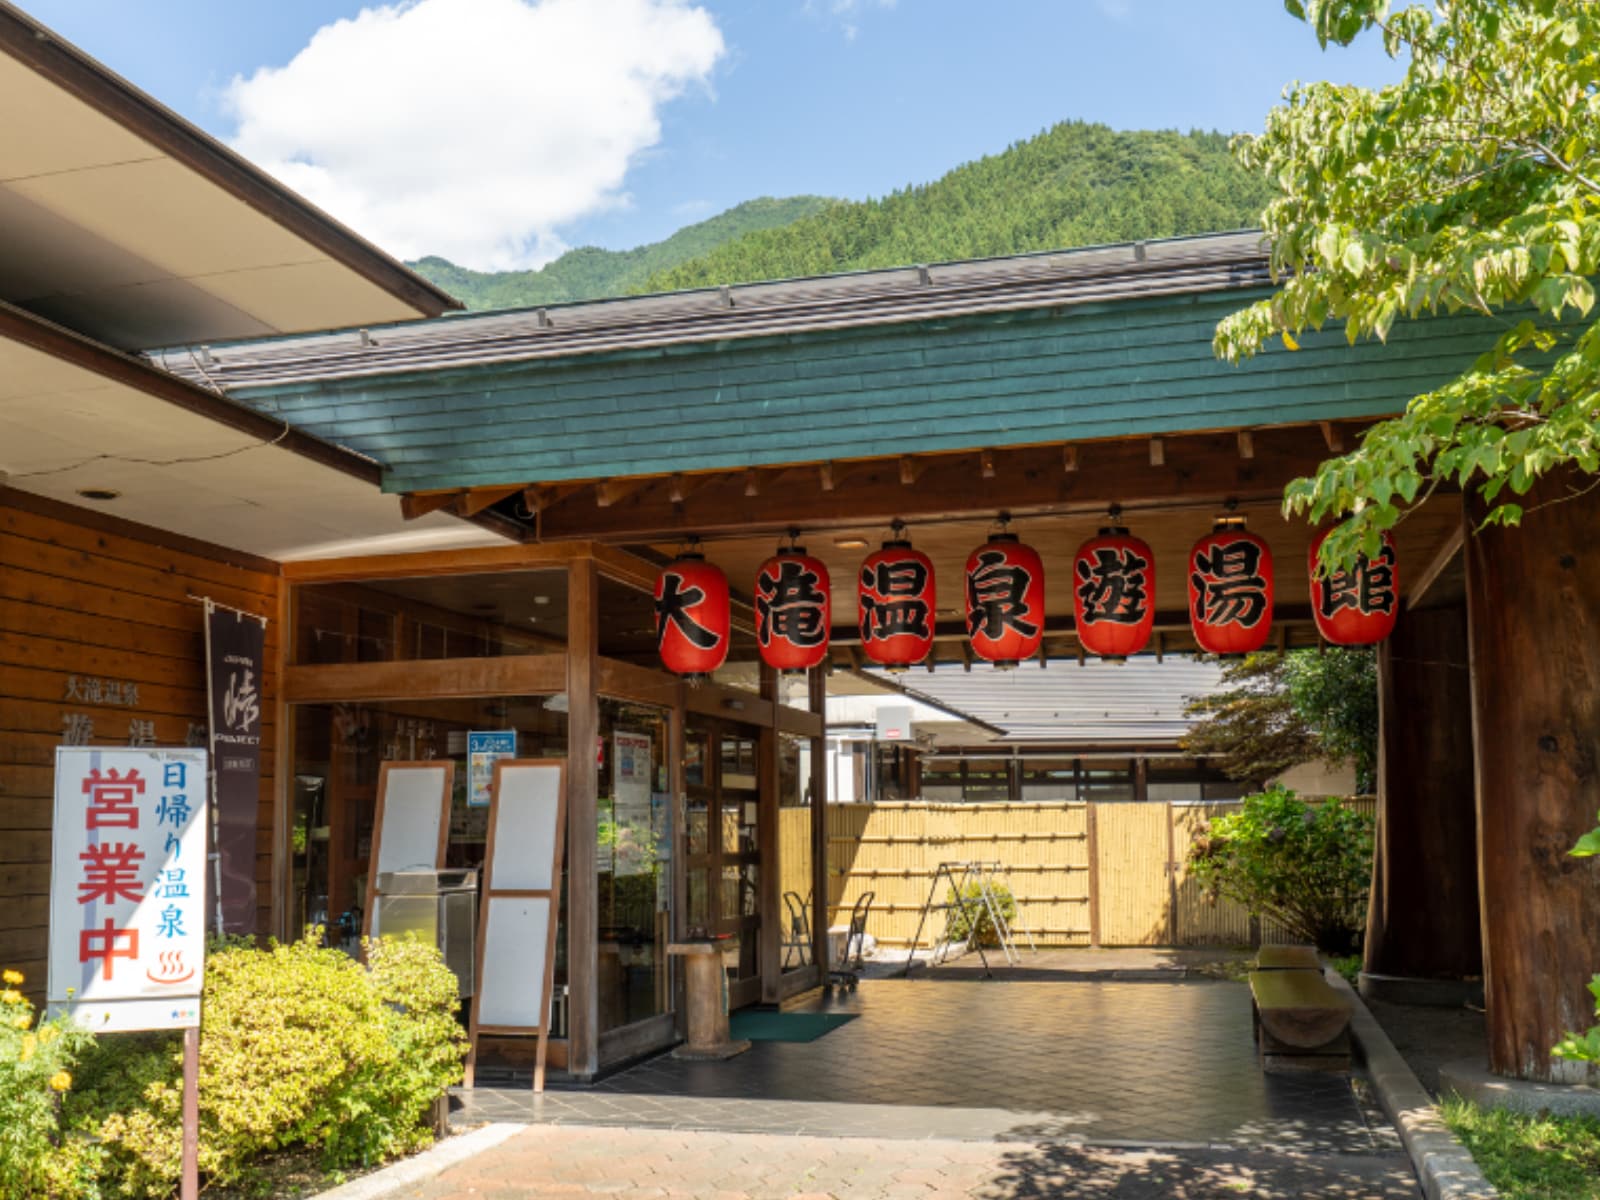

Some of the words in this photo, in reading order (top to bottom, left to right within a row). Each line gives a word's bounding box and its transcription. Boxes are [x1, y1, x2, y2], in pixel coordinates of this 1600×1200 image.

[65, 674, 140, 706] 大滝温泉
[76, 767, 147, 981] 営業中
[154, 761, 193, 940] 日帰り温泉
